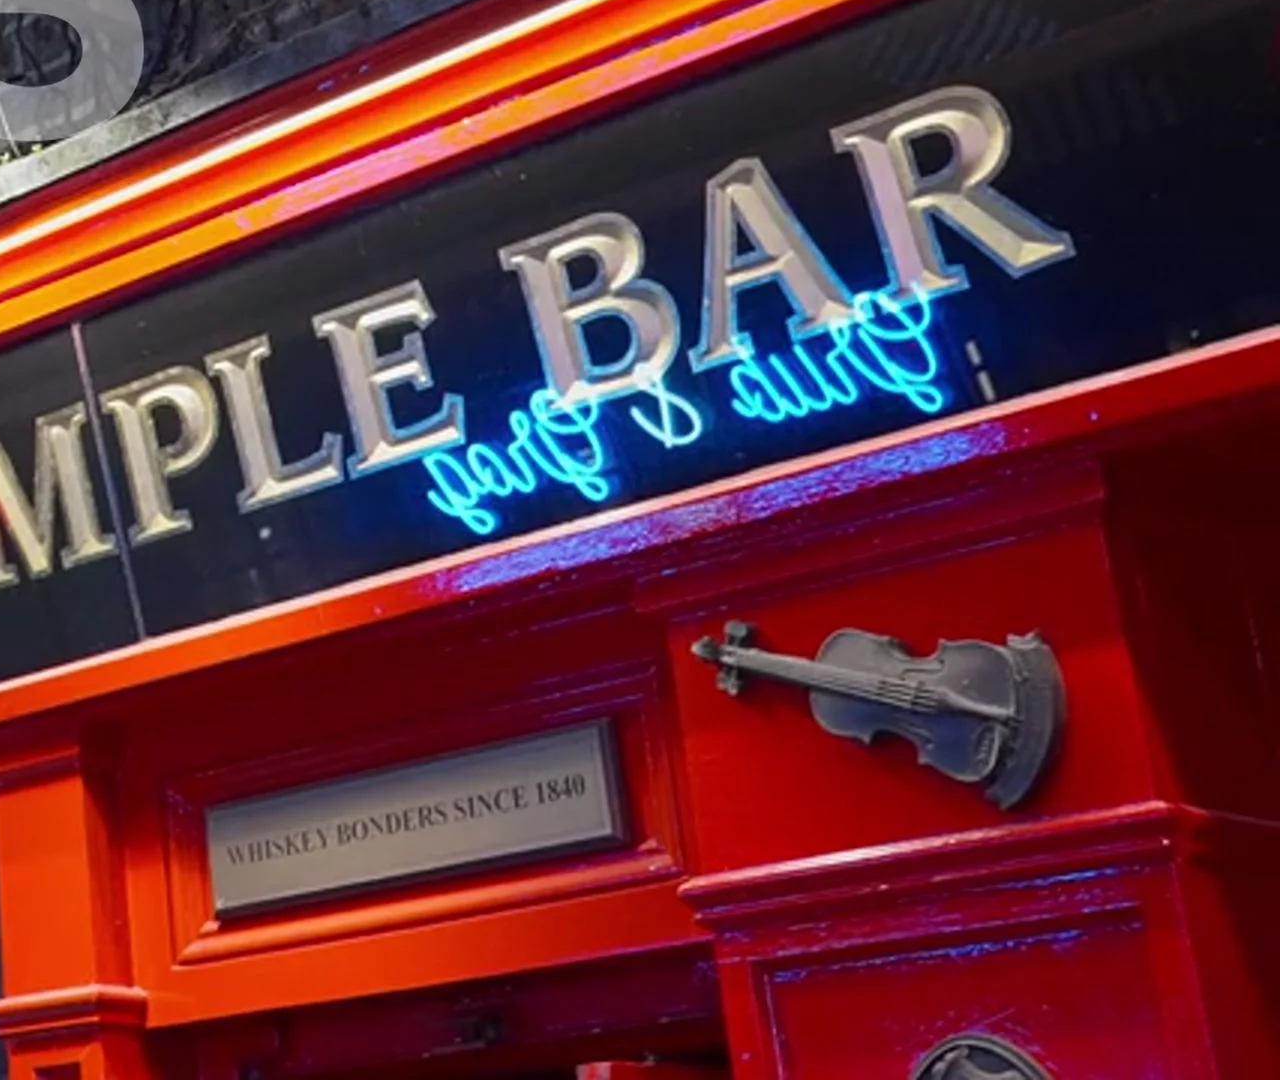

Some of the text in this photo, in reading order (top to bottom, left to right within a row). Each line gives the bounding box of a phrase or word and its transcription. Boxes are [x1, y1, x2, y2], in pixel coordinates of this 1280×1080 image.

[498, 84, 1075, 410] BAR
[227, 773, 586, 868] WHISKEY BONDERS SINCE 1840
